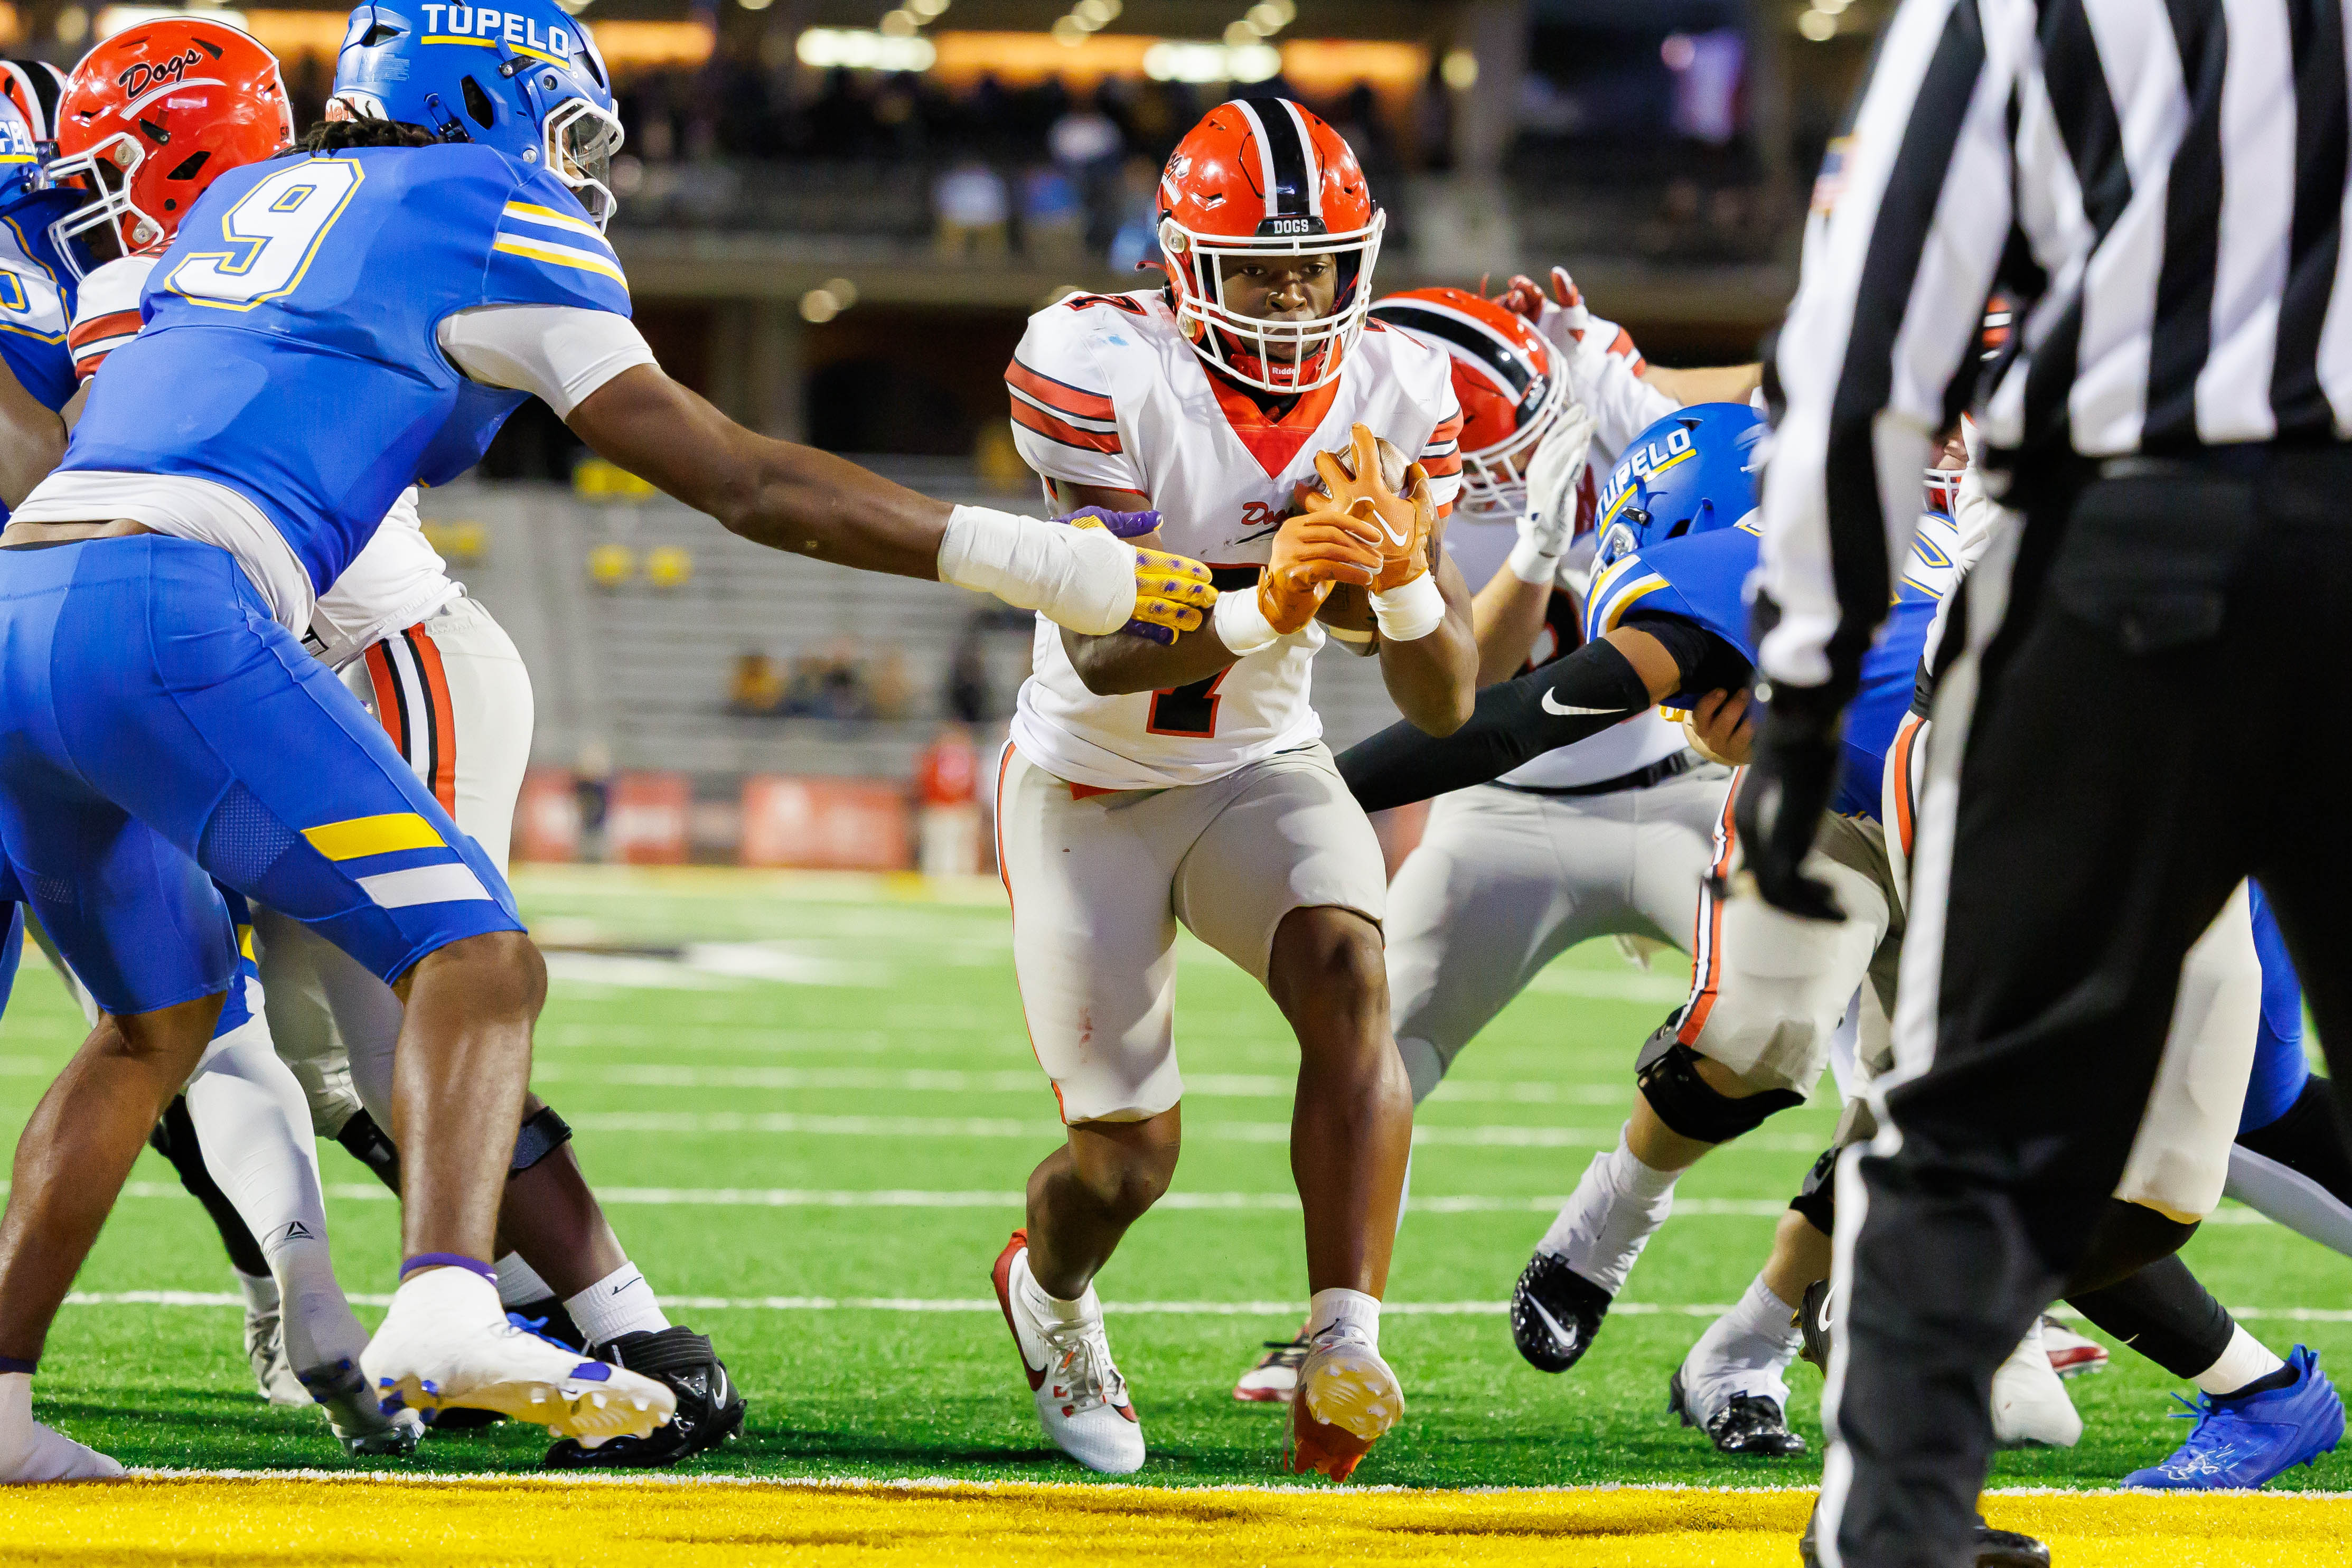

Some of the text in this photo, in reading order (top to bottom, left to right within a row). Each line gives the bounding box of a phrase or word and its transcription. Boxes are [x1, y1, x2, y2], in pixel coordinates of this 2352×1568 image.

[421, 4, 569, 59] TUPELO
[117, 48, 203, 99] Dogs
[164, 158, 365, 312] 9
[1273, 219, 1309, 233] DOGS
[1597, 428, 1691, 526] TUPELO
